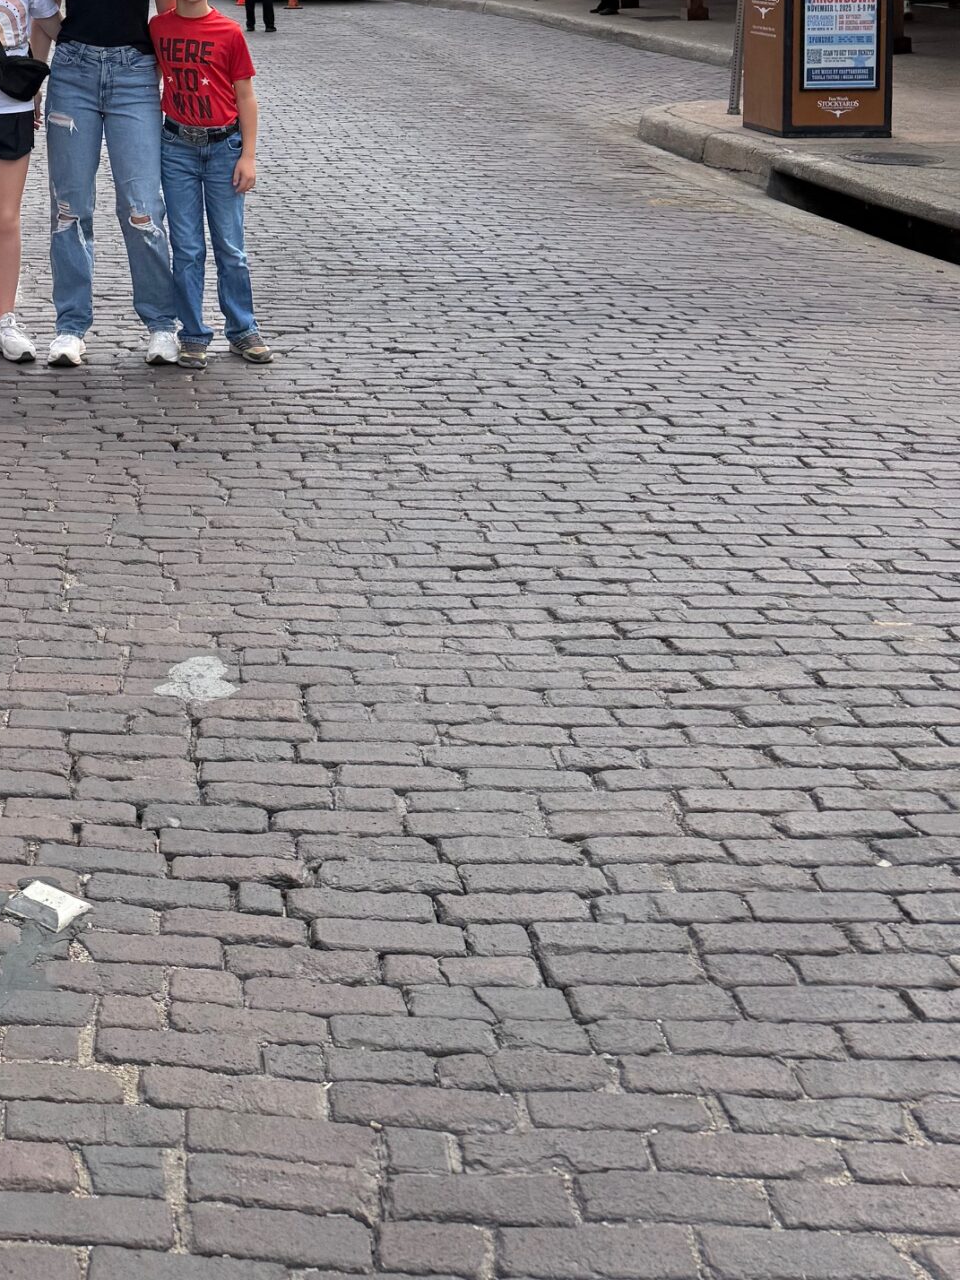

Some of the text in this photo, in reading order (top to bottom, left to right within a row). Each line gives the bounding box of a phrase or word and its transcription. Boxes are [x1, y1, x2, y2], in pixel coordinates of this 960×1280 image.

[159, 37, 215, 64] HERE
[172, 68, 198, 92] TO
[172, 91, 213, 118] WIN
[817, 100, 859, 108] STOCKYARDS
